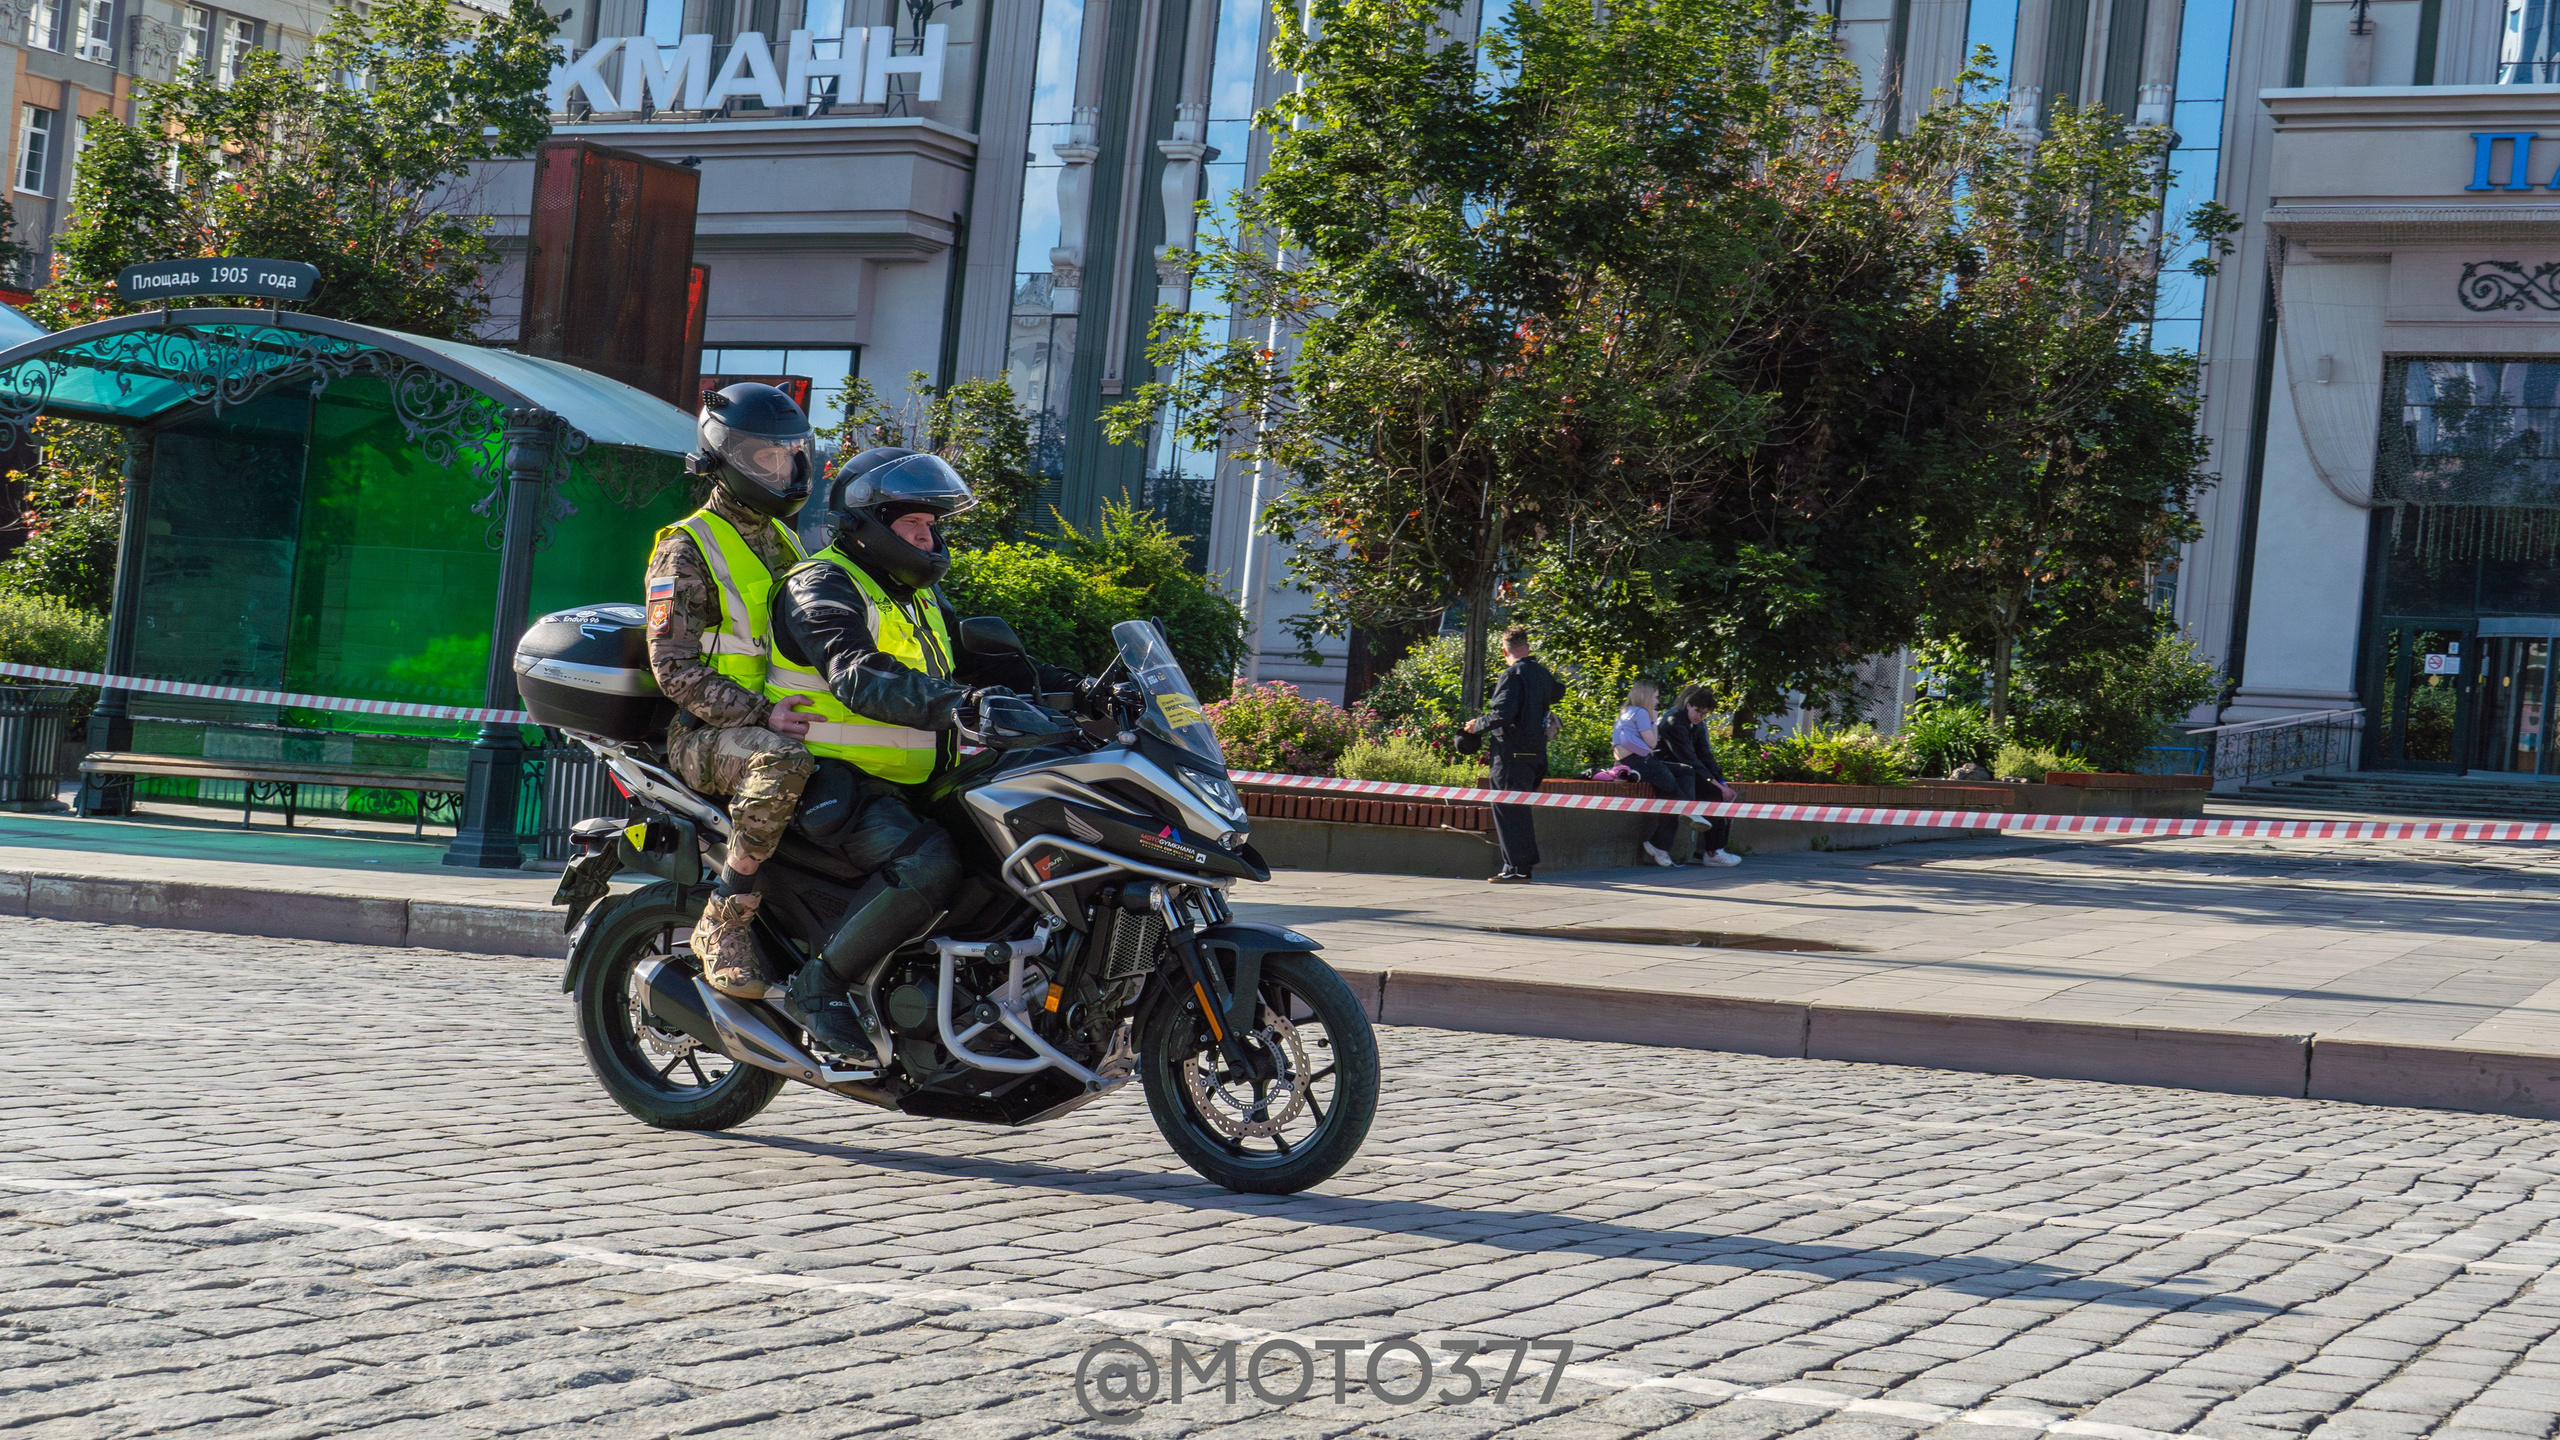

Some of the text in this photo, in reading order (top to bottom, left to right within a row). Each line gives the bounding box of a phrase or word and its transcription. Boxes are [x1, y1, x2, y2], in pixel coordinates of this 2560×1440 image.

[344, 24, 949, 113] КМАНН
[2464, 132, 2560, 190] П
[132, 267, 297, 290] Площадь 1905 года
[562, 615, 589, 623] Enduro
[805, 798, 838, 816] ROCKBROS
[1140, 833, 1196, 856] MOTOGYMKHANA
